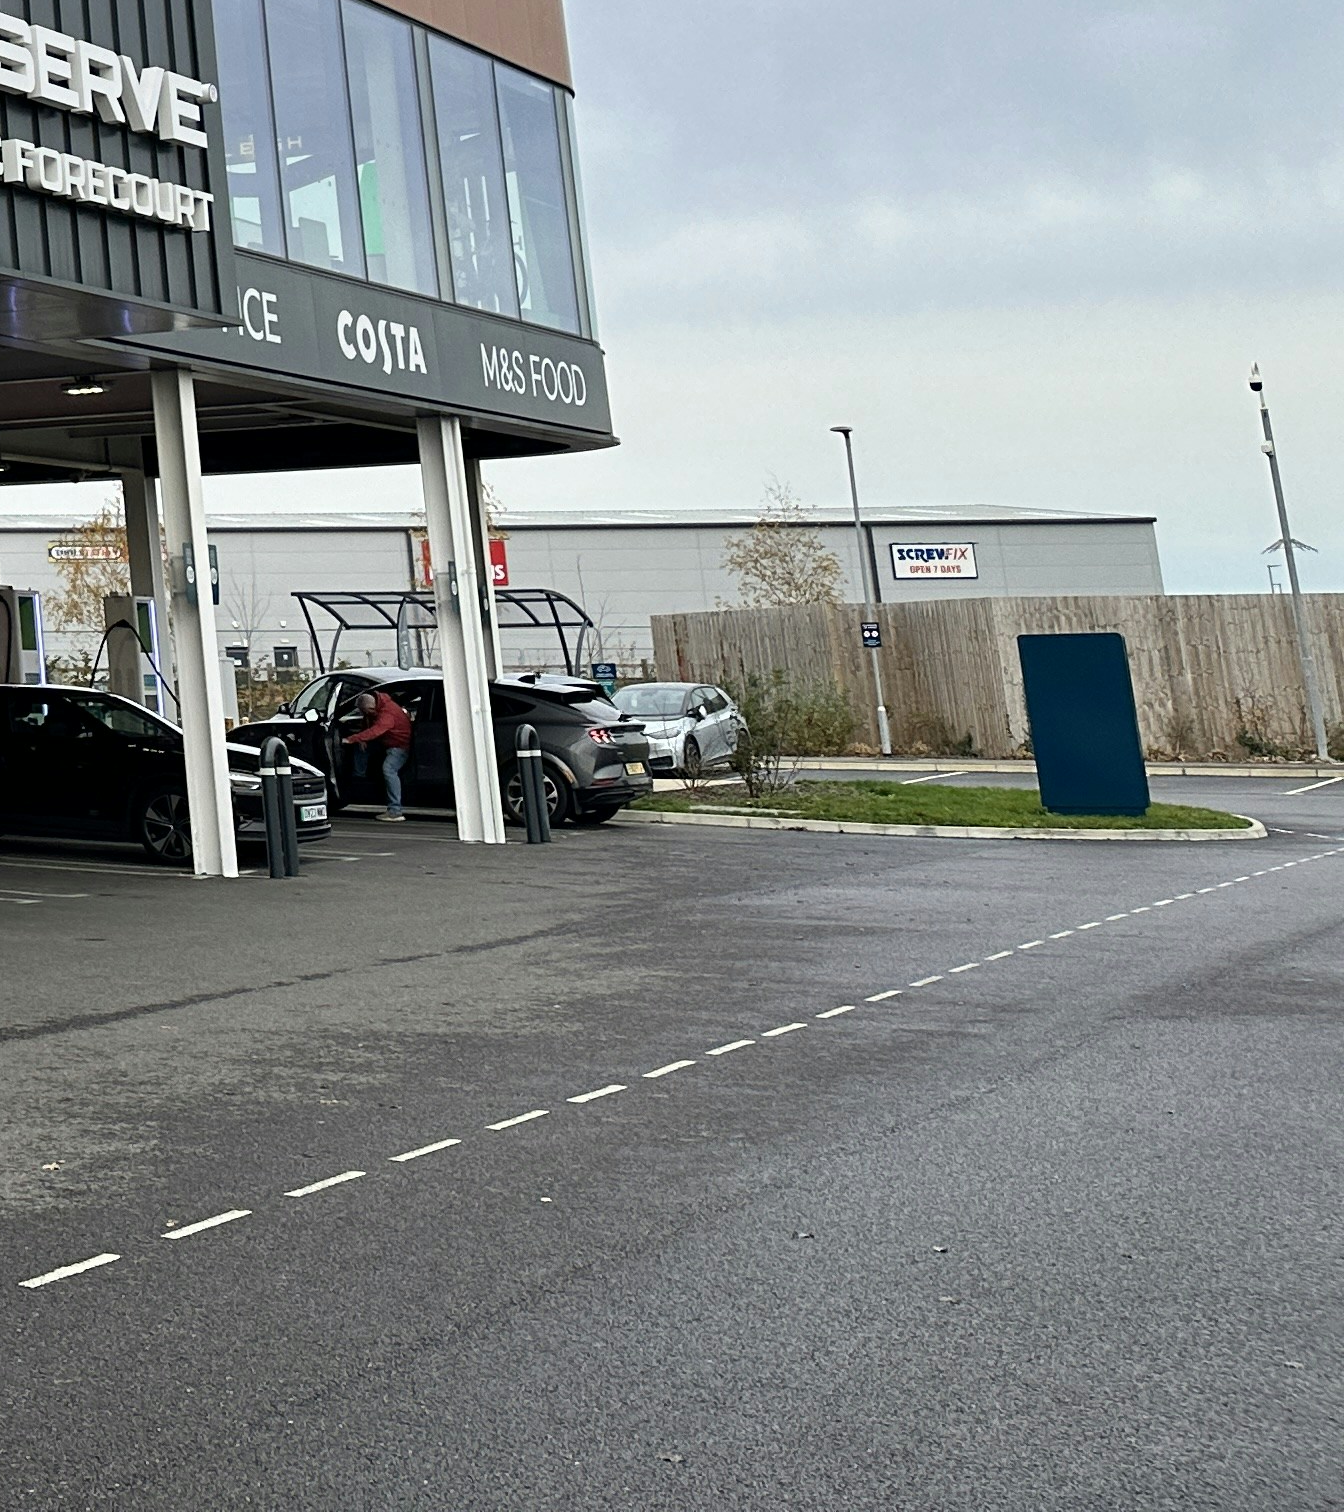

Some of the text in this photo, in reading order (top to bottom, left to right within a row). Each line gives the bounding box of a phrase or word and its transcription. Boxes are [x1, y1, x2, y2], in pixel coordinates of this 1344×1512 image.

[3, 138, 215, 232] FORECOURT
[236, 285, 282, 345] ICE
[337, 309, 428, 376] COSTA
[480, 342, 588, 407] M&S FOOD
[897, 547, 969, 562] SCREWFIX
[909, 565, 932, 574] OPEN
[940, 565, 962, 574] DAYS
